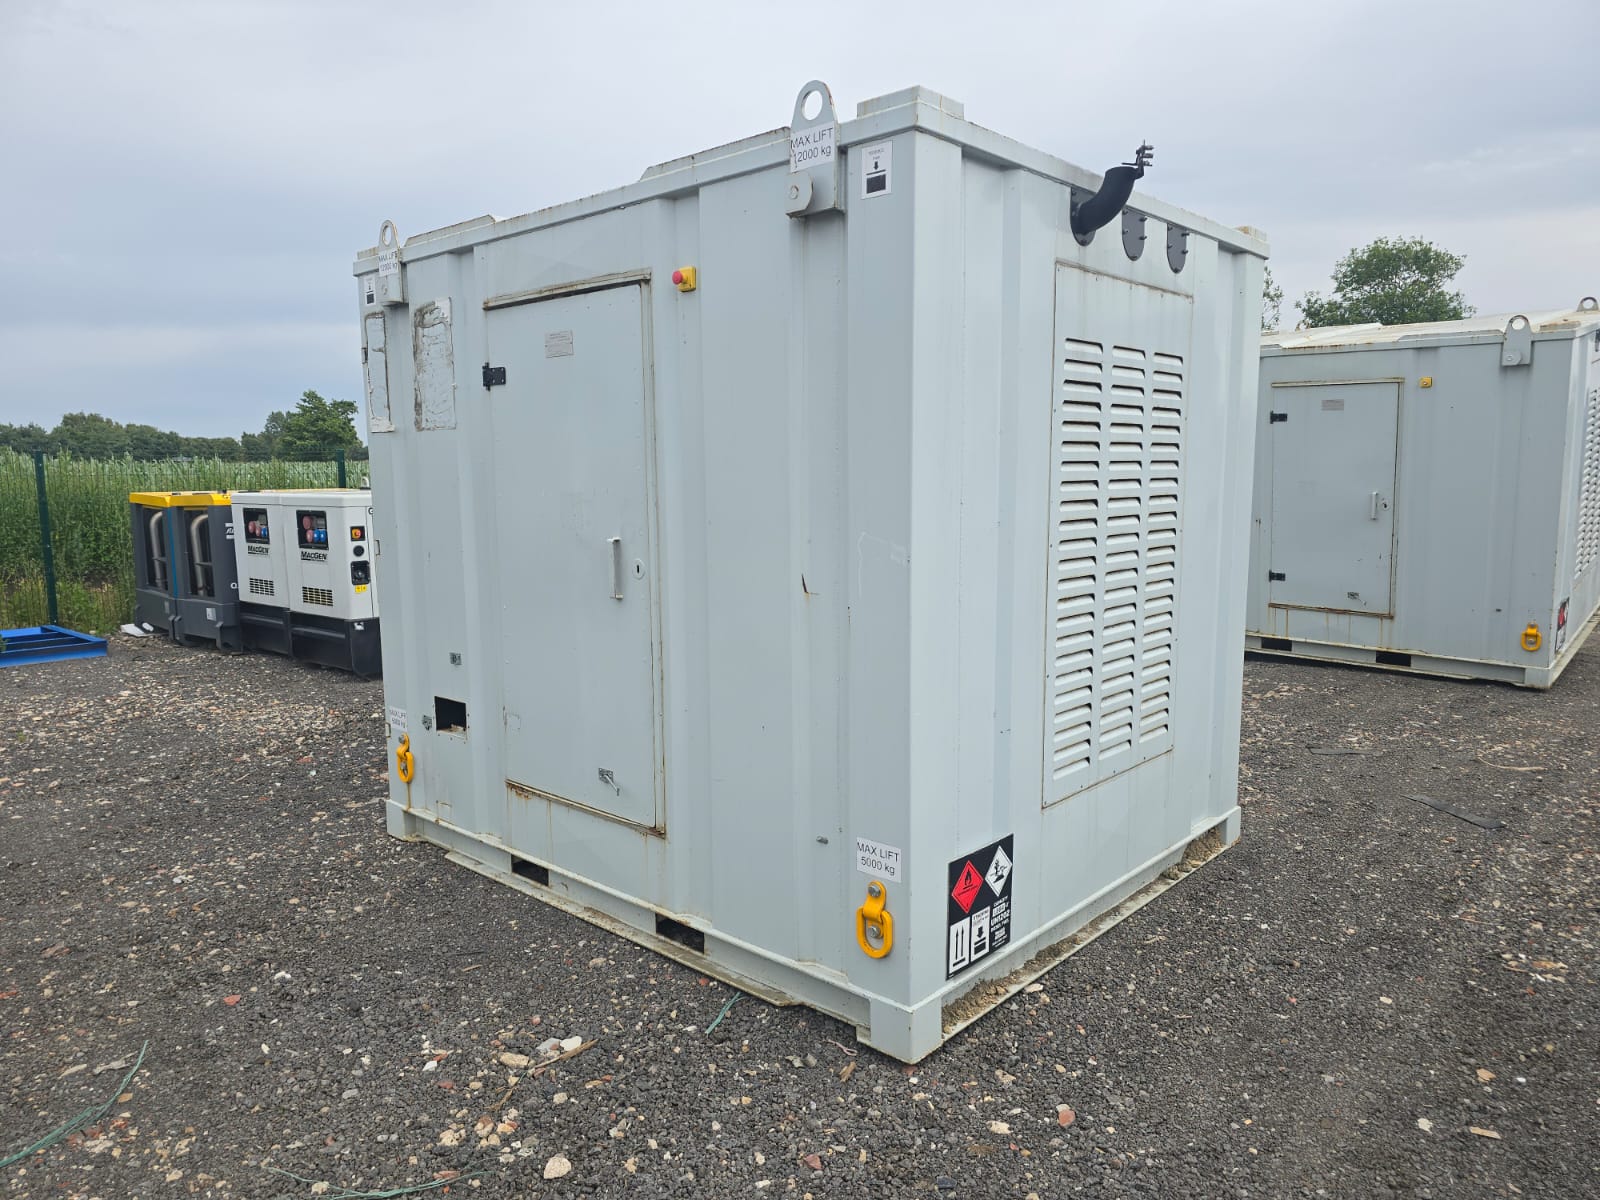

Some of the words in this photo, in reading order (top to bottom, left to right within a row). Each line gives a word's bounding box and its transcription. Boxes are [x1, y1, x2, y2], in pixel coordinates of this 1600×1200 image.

[791, 135, 811, 150] MAX
[813, 127, 834, 143] LIFT
[821, 145, 832, 158] kg
[857, 842, 877, 857] MAX
[880, 848, 900, 863] LIFT
[861, 856, 883, 871] 5000
[884, 861, 895, 876] kg
